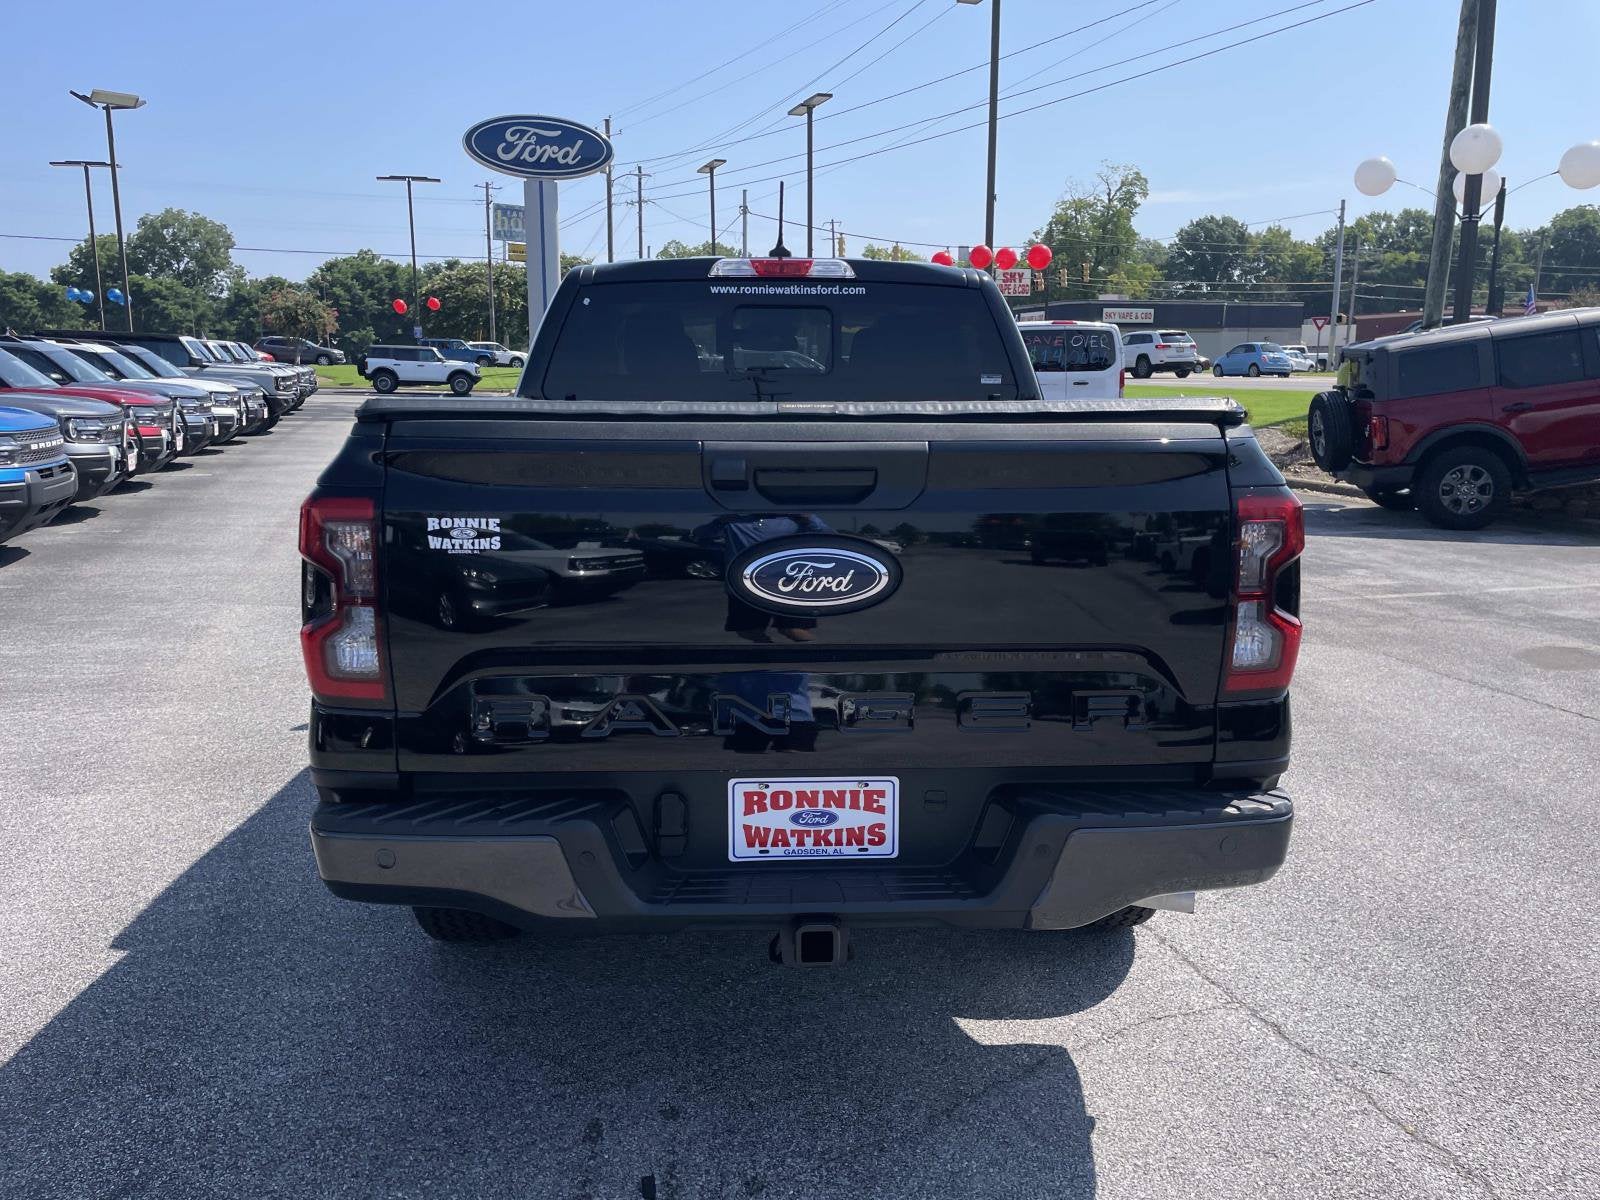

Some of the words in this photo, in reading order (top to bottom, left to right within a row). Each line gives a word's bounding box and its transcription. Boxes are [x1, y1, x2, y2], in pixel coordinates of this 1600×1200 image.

[496, 125, 584, 165] Ford
[1002, 271, 1025, 284] SKY
[710, 284, 866, 296] www.ronniewatkinsford.com
[997, 283, 1012, 295] APE
[1018, 283, 1030, 295] CBD
[1104, 311, 1117, 320] SKY
[1118, 311, 1134, 320] VAPE
[1140, 311, 1153, 320] CBD
[1024, 335, 1065, 347] SAVE
[1071, 333, 1111, 350] OVER
[426, 517, 501, 532] RONNIE
[427, 535, 501, 550] WATKINS
[777, 560, 855, 593] Ford
[471, 689, 1146, 737] RANGER
[742, 789, 887, 817] RONNIE
[799, 811, 830, 824] Ford
[742, 822, 887, 848] WATKINS
[783, 848, 831, 856] GADSDEN,
[832, 848, 845, 856] AL
